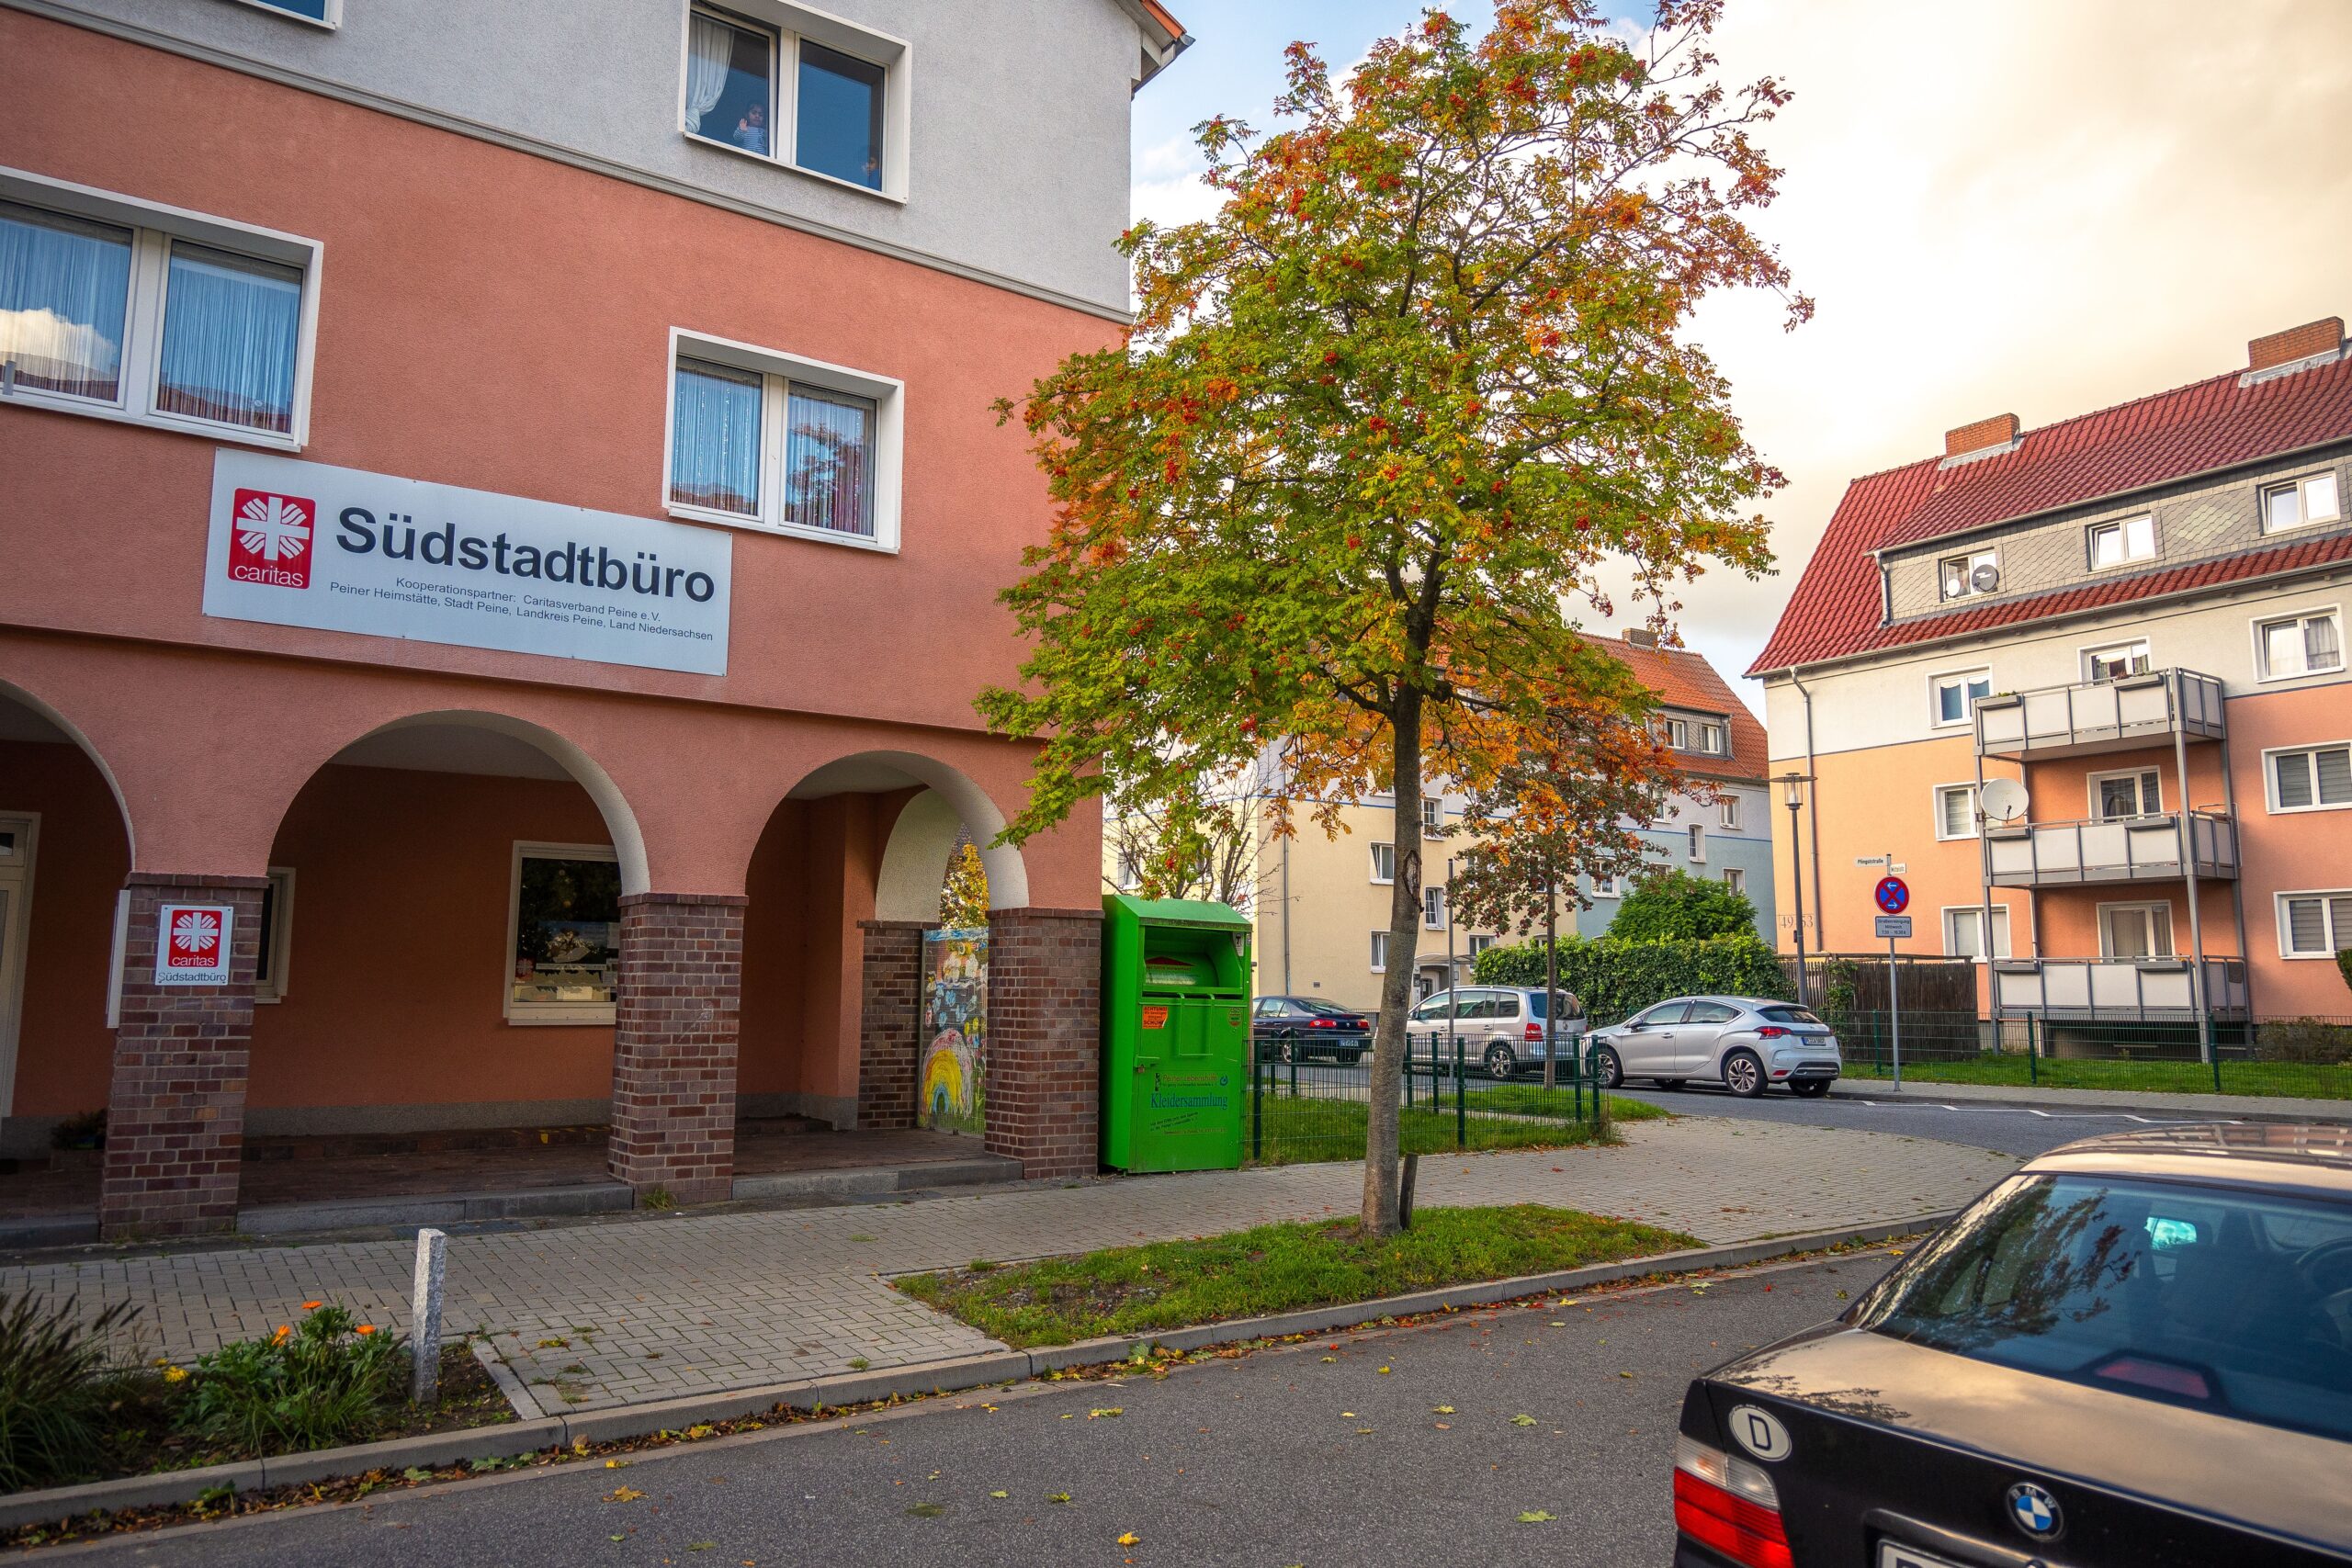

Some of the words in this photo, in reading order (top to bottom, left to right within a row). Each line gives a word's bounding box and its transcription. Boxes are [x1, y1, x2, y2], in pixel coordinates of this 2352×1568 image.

[335, 506, 715, 603] Südstadtbüro
[234, 565, 304, 587] caritas
[396, 577, 516, 603] Kooperationspartner:
[523, 594, 605, 615] Caritasverband
[607, 606, 638, 619] Peine
[330, 581, 370, 596] Peiner
[374, 588, 441, 607] Heimstätte,
[444, 596, 474, 610] Stadt
[477, 601, 512, 616] Peine,
[516, 607, 570, 623] Landkreis
[572, 615, 606, 628] Peine,
[609, 619, 636, 631] Land
[639, 623, 713, 641] Niedersachsen
[171, 954, 215, 966] caritas
[157, 972, 227, 983] Südstadtbüro
[1150, 1092, 1228, 1111] Kleidersammlung
[1747, 1413, 1773, 1451] D
[2010, 1486, 2056, 1509] BMW
